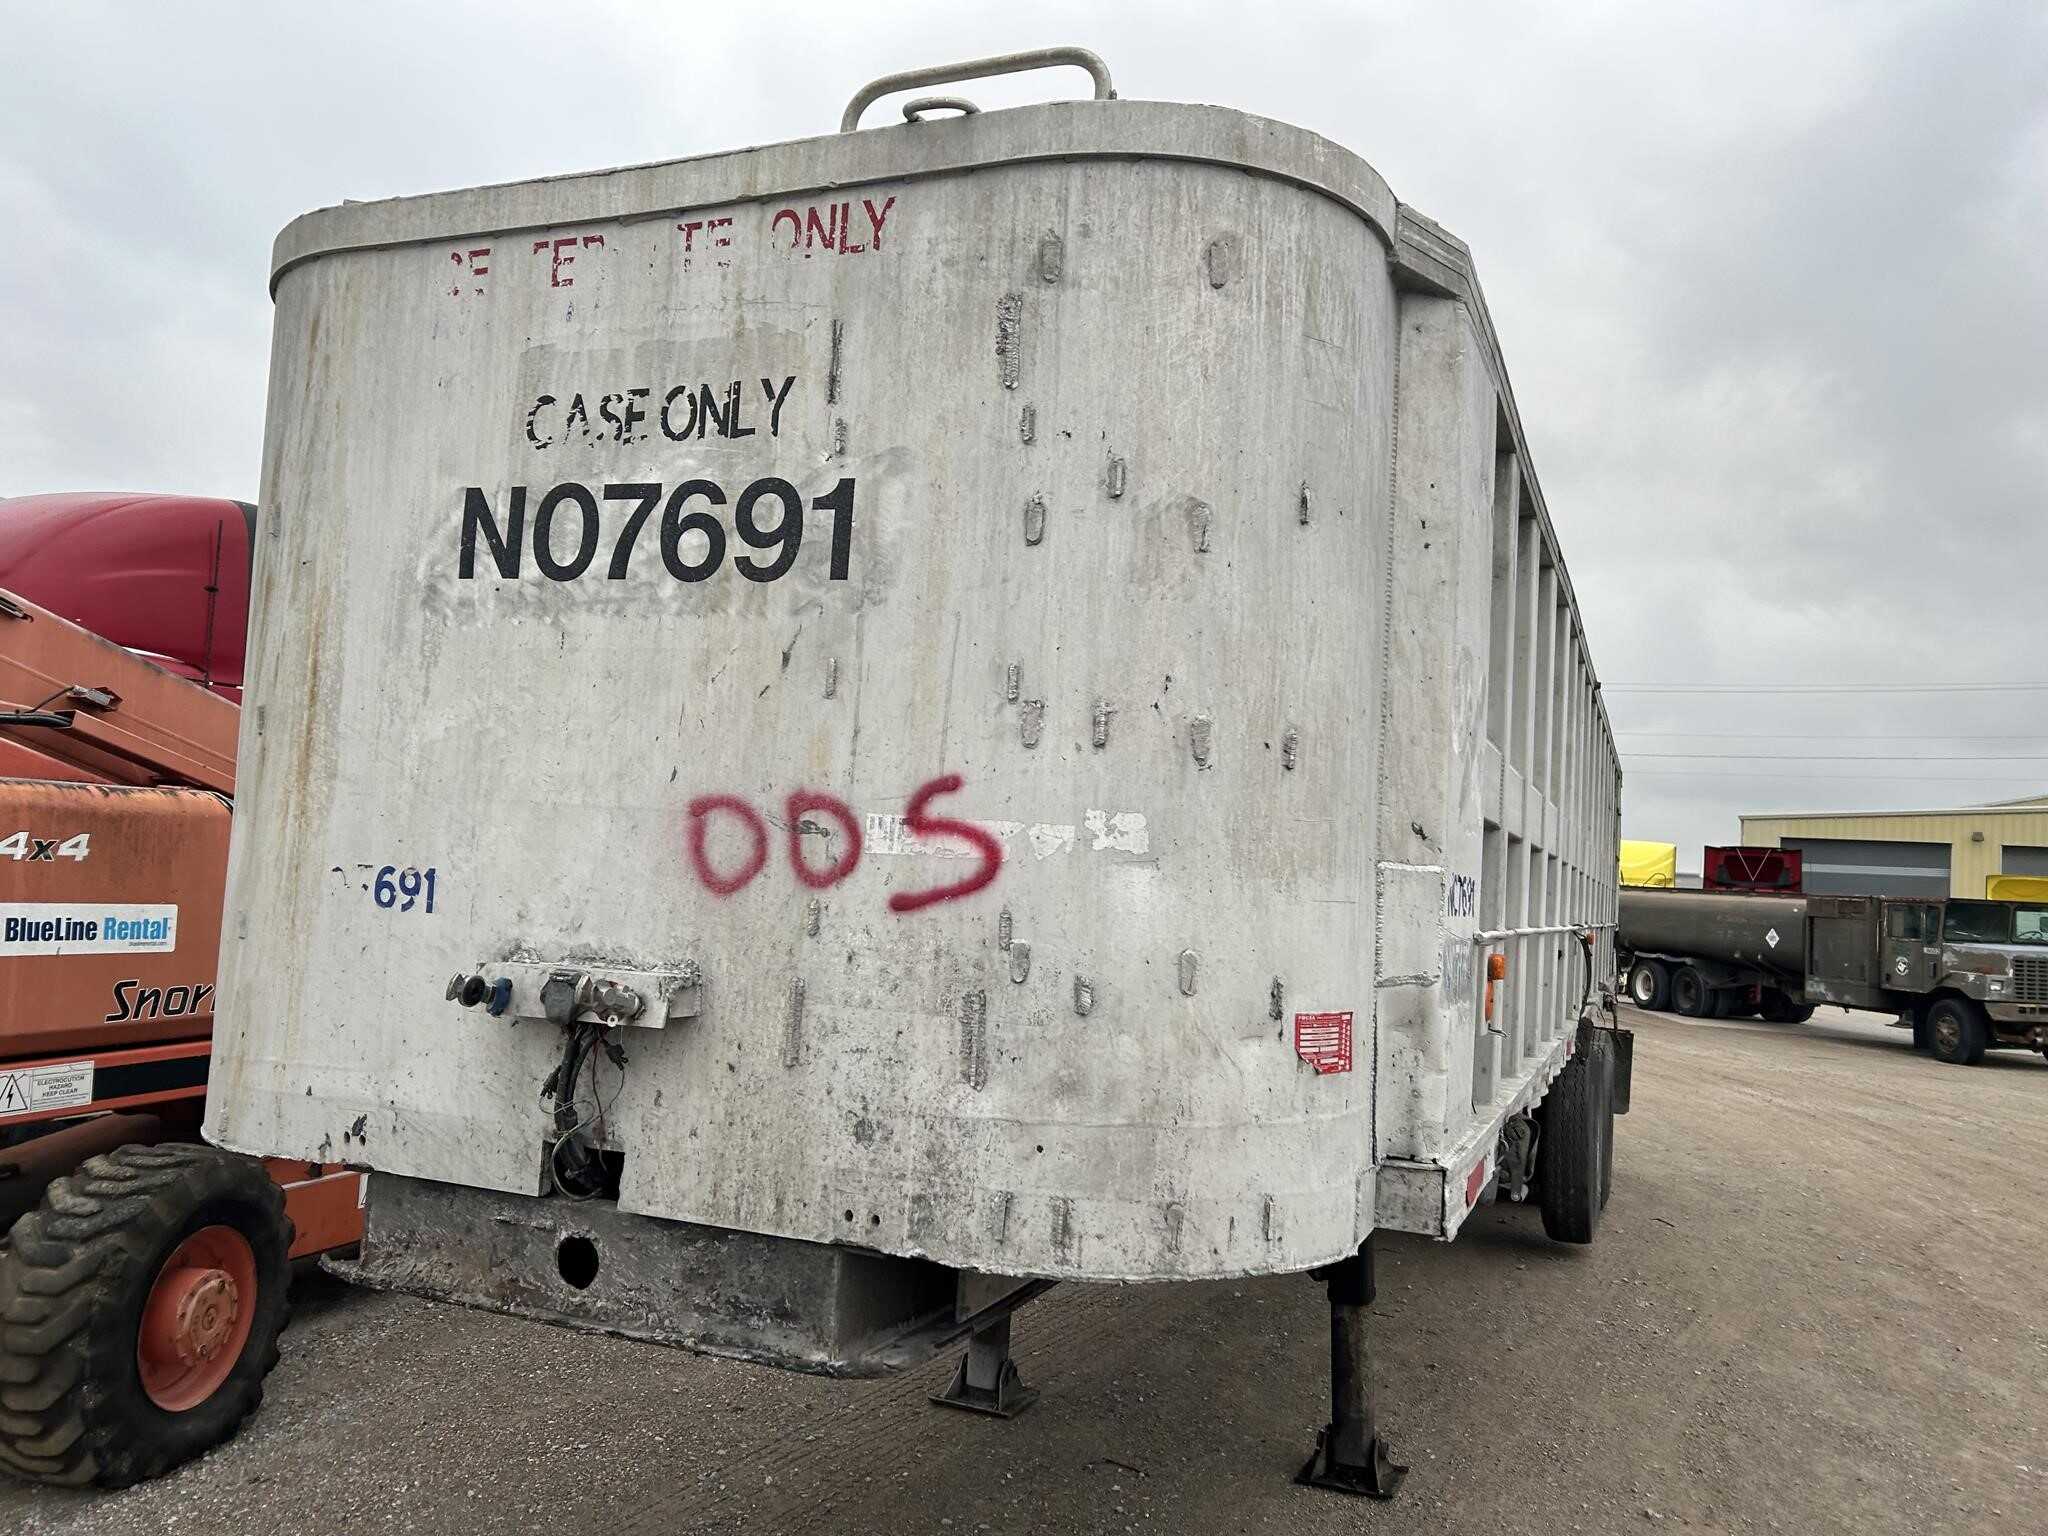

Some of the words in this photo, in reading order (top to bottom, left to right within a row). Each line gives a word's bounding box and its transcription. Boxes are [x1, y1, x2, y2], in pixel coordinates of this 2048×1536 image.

[771, 195, 897, 257] ONLY
[525, 388, 650, 450] CASE
[659, 376, 796, 441] ONLY
[458, 477, 856, 583] N07691
[4, 917, 98, 942] BlueLine
[103, 917, 169, 941] Rental
[104, 979, 215, 1024] Snor
[42, 1089, 59, 1097] KEEP
